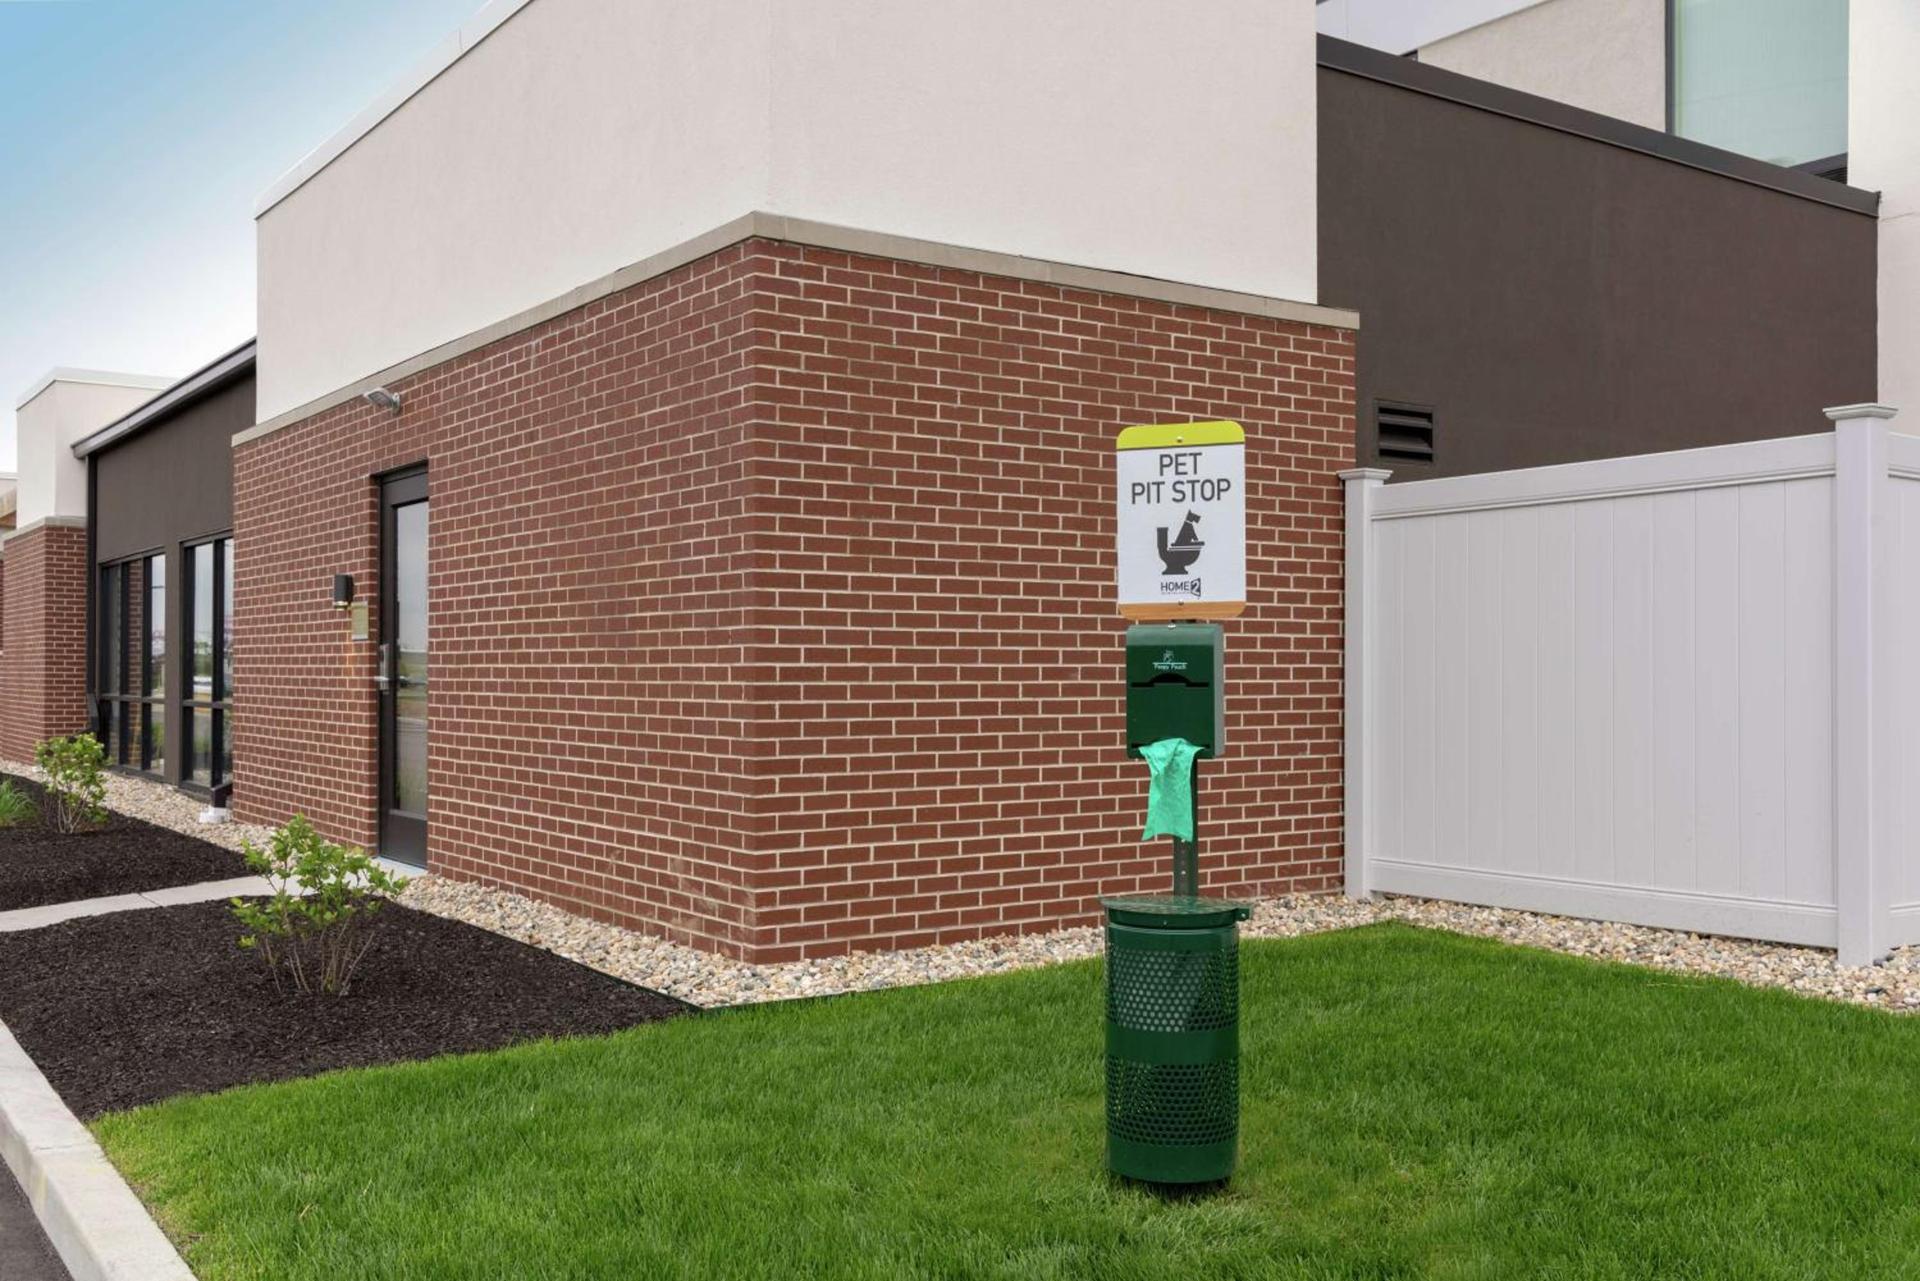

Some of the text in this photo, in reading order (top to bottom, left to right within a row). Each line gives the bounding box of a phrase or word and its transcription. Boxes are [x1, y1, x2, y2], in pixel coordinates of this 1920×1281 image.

[1159, 452, 1203, 476] PET
[1131, 478, 1231, 504] PIT STOP
